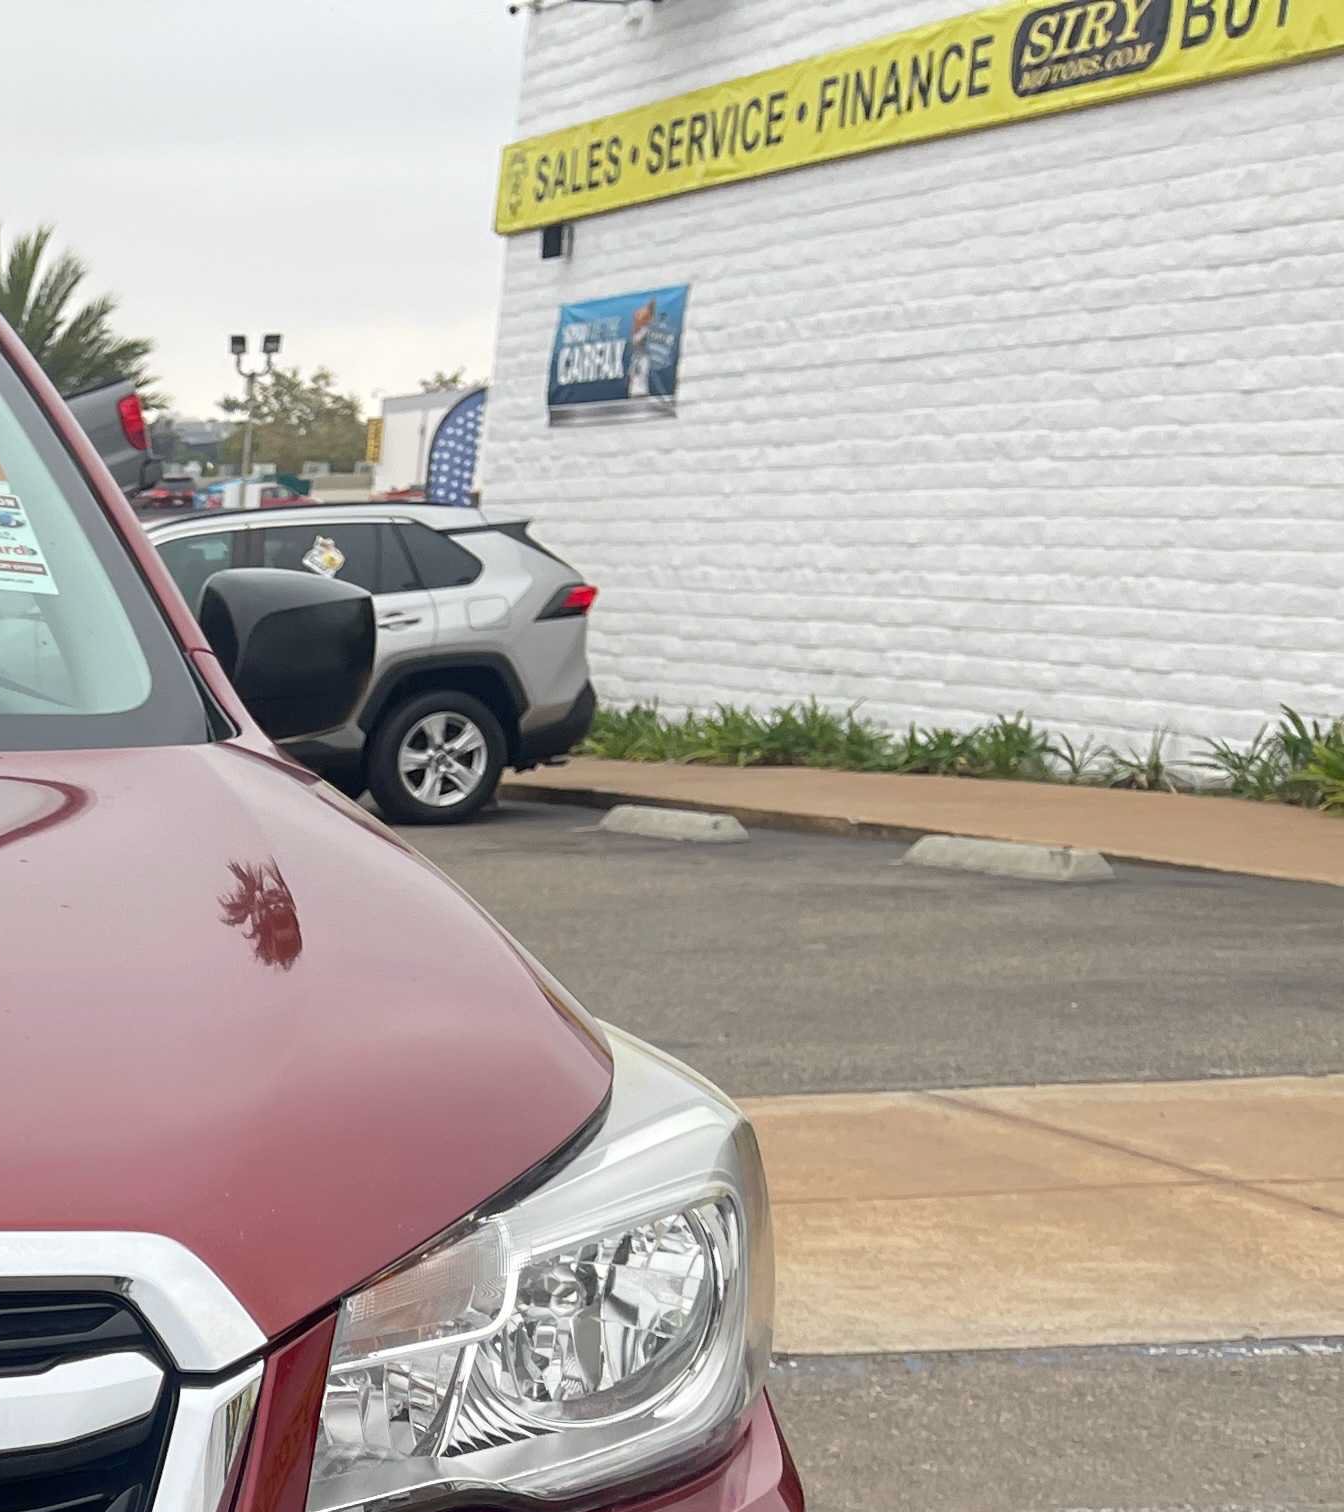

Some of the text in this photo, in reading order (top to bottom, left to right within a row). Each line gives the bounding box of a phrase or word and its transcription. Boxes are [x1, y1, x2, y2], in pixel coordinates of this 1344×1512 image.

[1020, 0, 1154, 67] SIRY
[1018, 41, 1154, 89] MOTORS.COM
[534, 135, 623, 203] SALES
[646, 90, 788, 175] SERVICE
[816, 34, 995, 133] FINANCE
[558, 340, 626, 385] CARFAX
